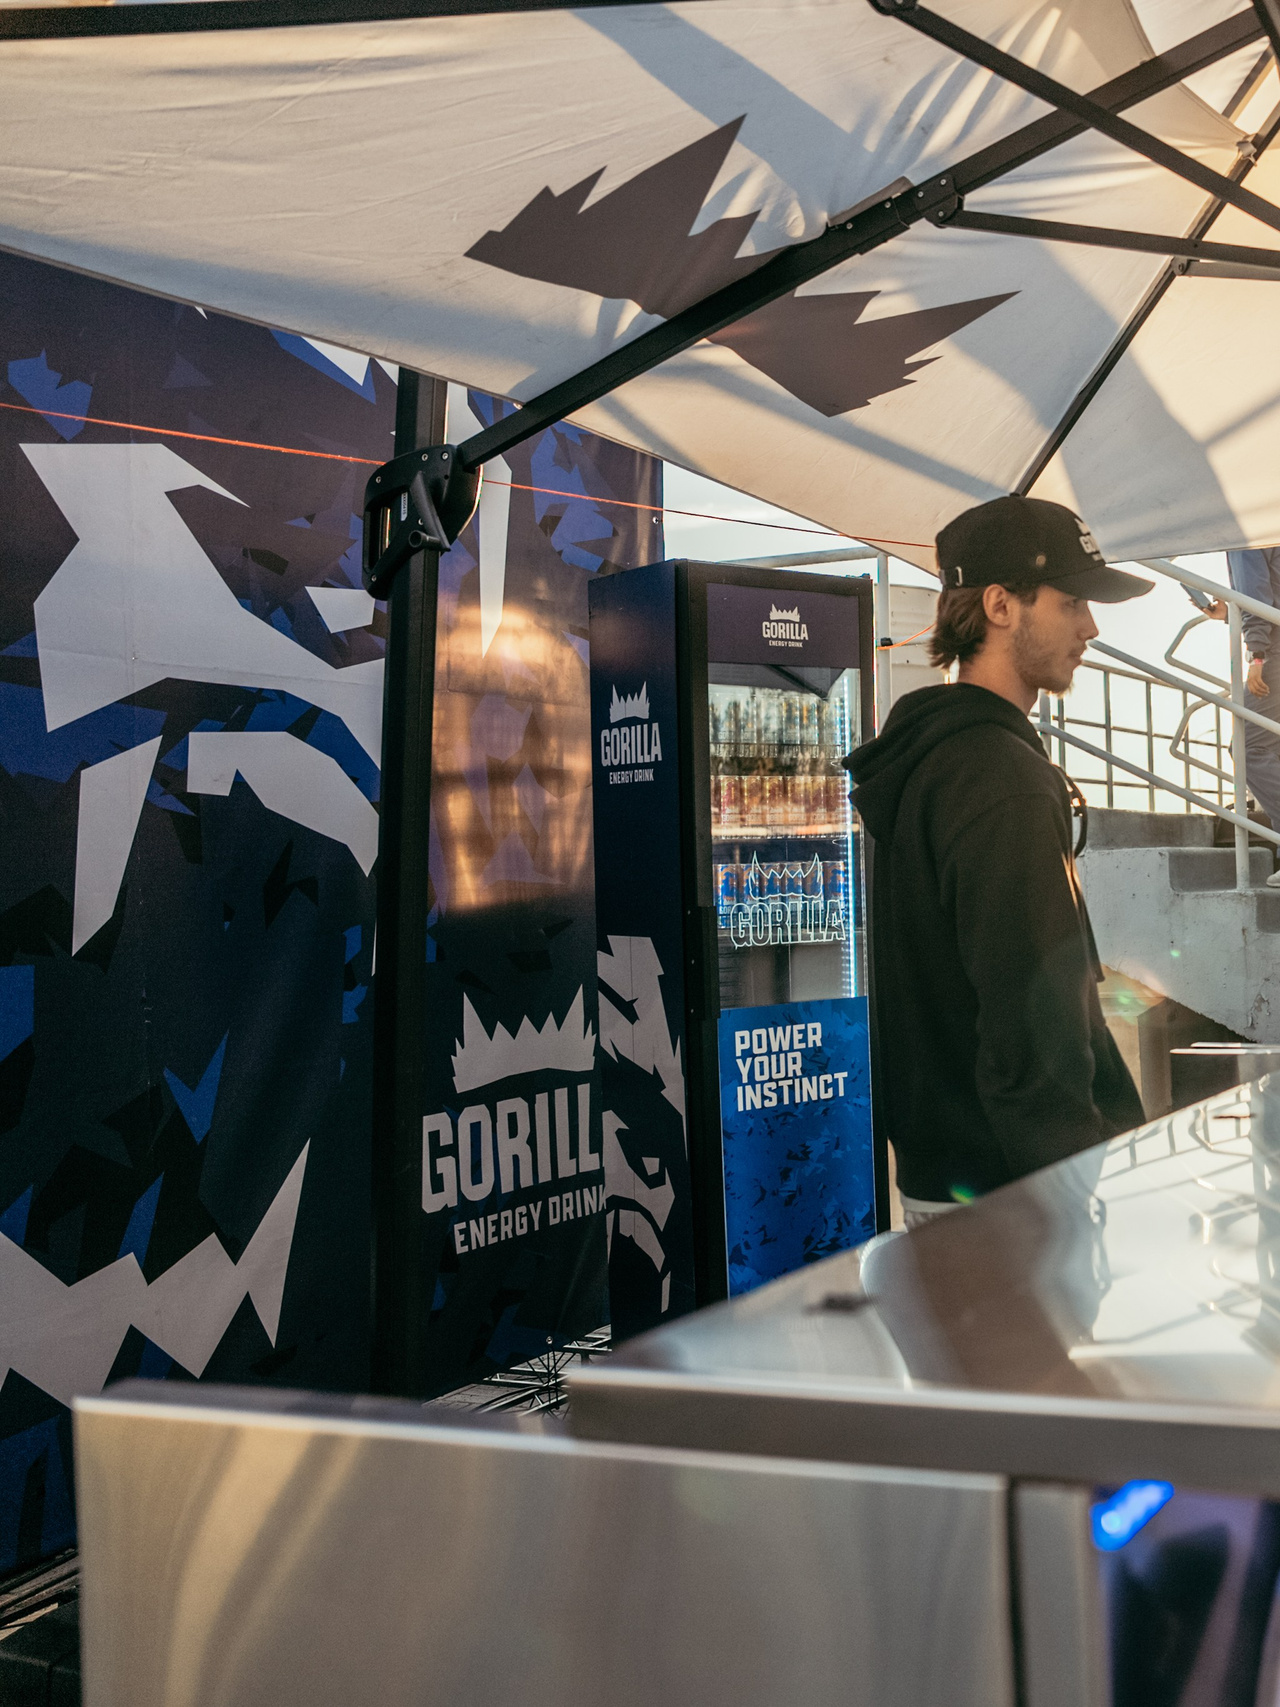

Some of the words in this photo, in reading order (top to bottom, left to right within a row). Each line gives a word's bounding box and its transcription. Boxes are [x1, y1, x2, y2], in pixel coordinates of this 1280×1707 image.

[762, 621, 809, 641] GORILLA
[600, 722, 663, 767] GORILLA
[609, 772, 634, 784] ENERGY
[633, 768, 655, 782] DRINK
[730, 900, 846, 948] GORILLA
[734, 1022, 822, 1057] POWER
[736, 1051, 803, 1084] YOUR
[737, 1071, 848, 1112] INSTINCT
[421, 1082, 604, 1214] GORILL
[454, 1200, 541, 1255] ENERGY
